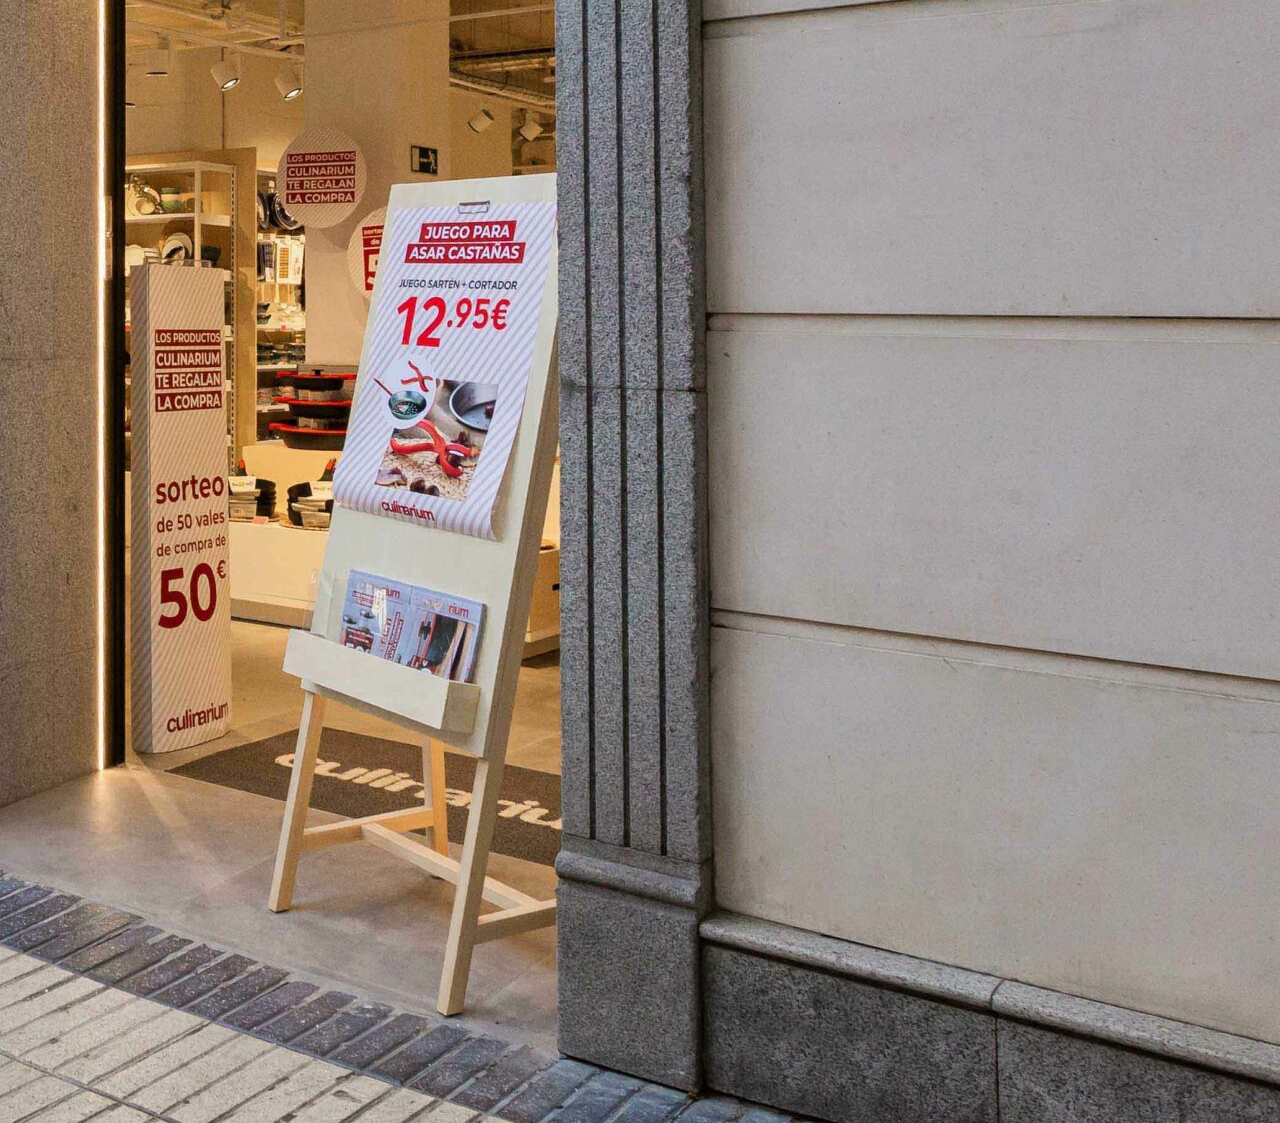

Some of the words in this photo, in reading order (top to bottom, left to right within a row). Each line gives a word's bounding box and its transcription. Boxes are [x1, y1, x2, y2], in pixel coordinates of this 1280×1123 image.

[287, 155, 304, 163] LOS
[305, 152, 356, 162] PRODUCTOS
[288, 165, 355, 177] CULINARIUM
[287, 180, 301, 190] TE
[303, 179, 355, 189] REGALAN
[288, 194, 303, 203] LA
[305, 192, 354, 203] COMPRA
[424, 226, 471, 240] JUEGO
[472, 224, 510, 238] PARA
[409, 246, 446, 260] ASAR
[447, 242, 520, 260] CASTAÑAS
[399, 279, 427, 289] JUEGO
[468, 280, 518, 290] CORTADOR
[397, 296, 511, 348] 12.95€
[155, 332, 172, 343] LOS
[173, 332, 220, 343] PRODUCTOS
[156, 352, 220, 366] CULINARIUM
[156, 374, 170, 388] TE
[172, 372, 220, 387] REGALAN
[157, 396, 172, 410] LA
[174, 394, 221, 409] COMPRA
[156, 475, 224, 504] sorteo
[381, 500, 435, 521] culinarium
[156, 516, 173, 533] de
[177, 513, 193, 531] 50
[195, 509, 225, 527] vales
[156, 543, 171, 558] de
[174, 538, 213, 555] compra
[215, 533, 226, 547] de
[166, 702, 229, 733] culinarium
